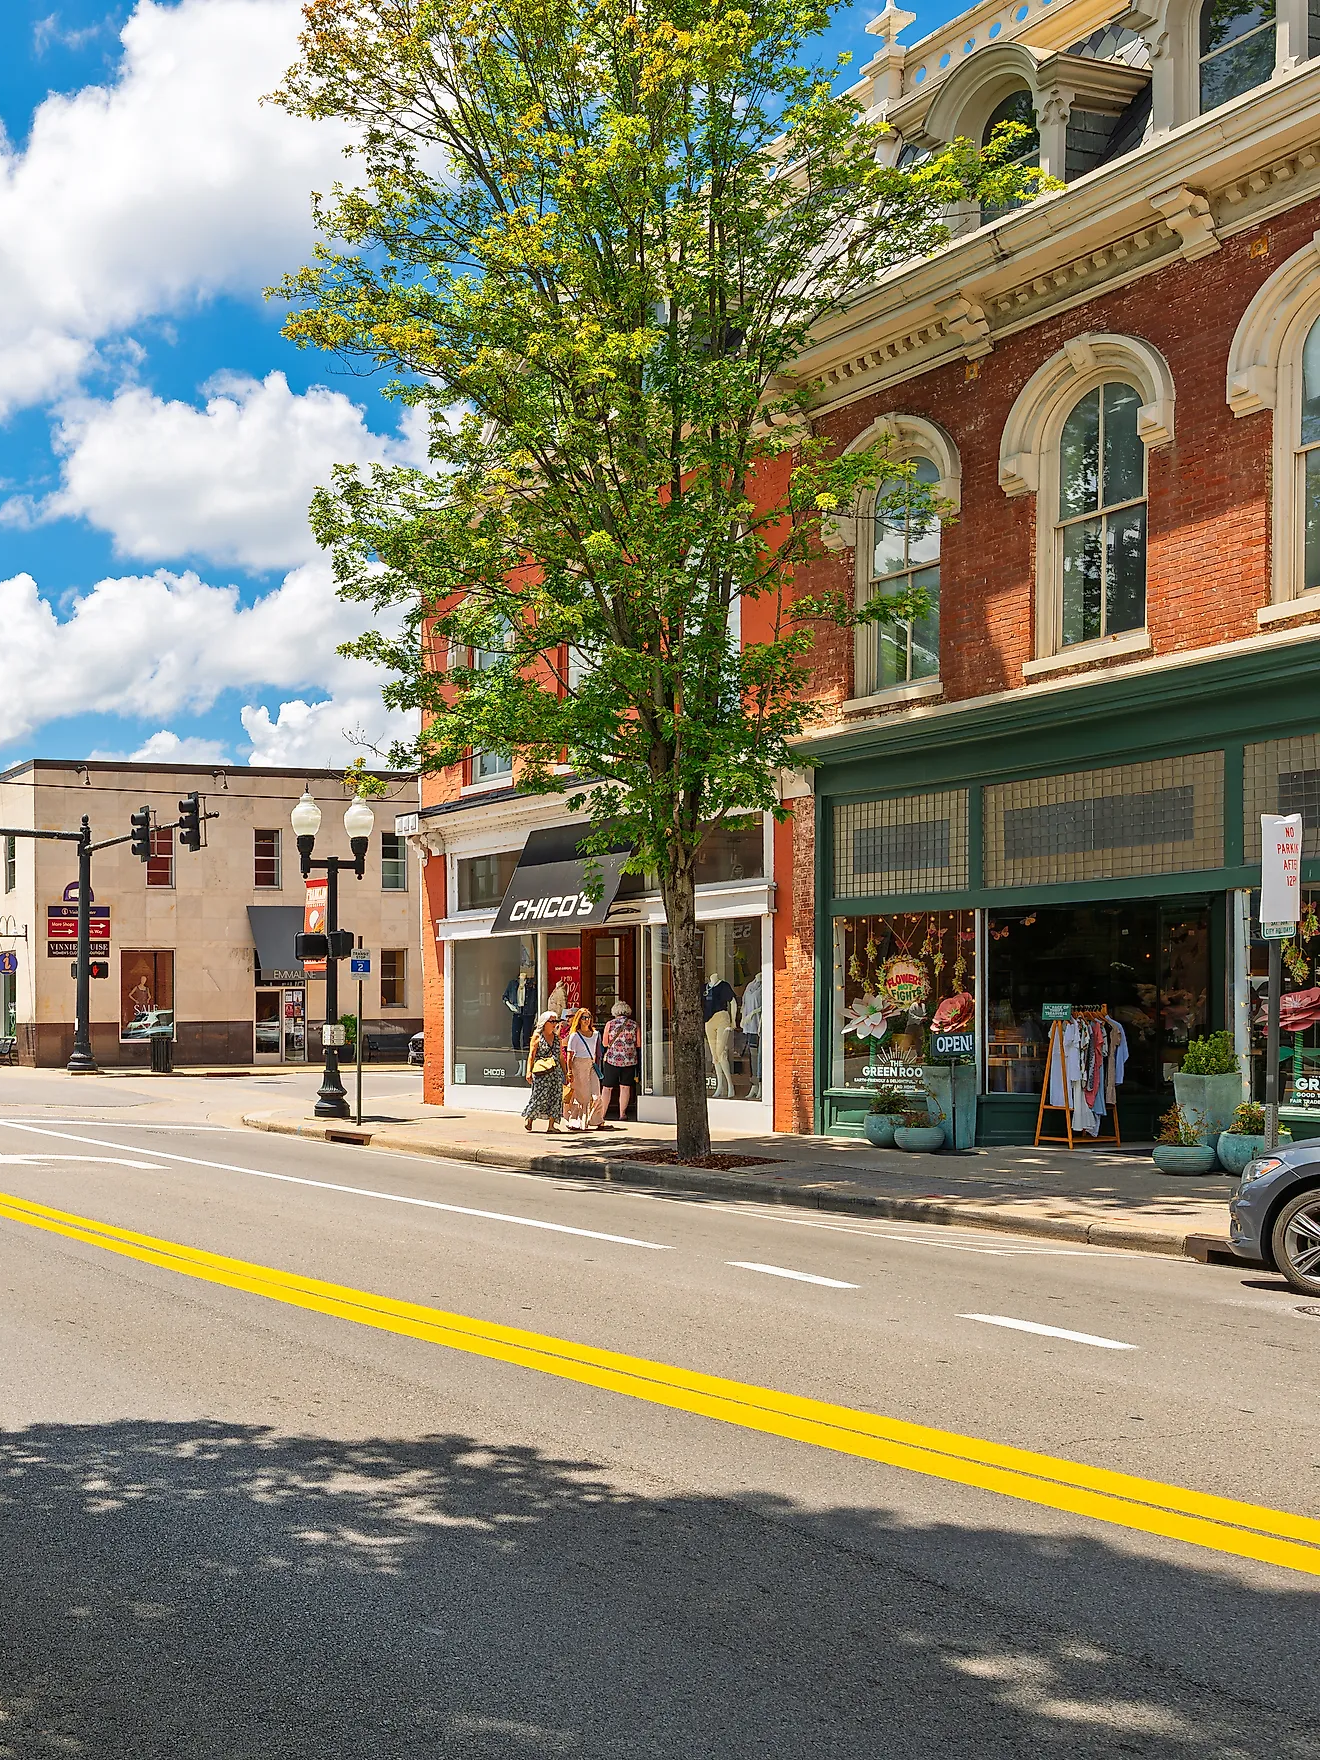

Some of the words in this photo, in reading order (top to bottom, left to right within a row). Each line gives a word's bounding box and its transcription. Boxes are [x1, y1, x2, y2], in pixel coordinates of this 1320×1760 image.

[1285, 826, 1294, 838] NO
[50, 943, 78, 951] VINNIE
[357, 963, 364, 972] 2
[273, 969, 317, 980] EMMALINE
[887, 974, 922, 988] FLOWERS
[897, 983, 914, 991] NOT
[890, 986, 922, 1001] FIGHTS
[936, 1034, 973, 1053] OPEN!
[483, 1068, 506, 1076] CHICO'S
[862, 1066, 898, 1077] GREEN
